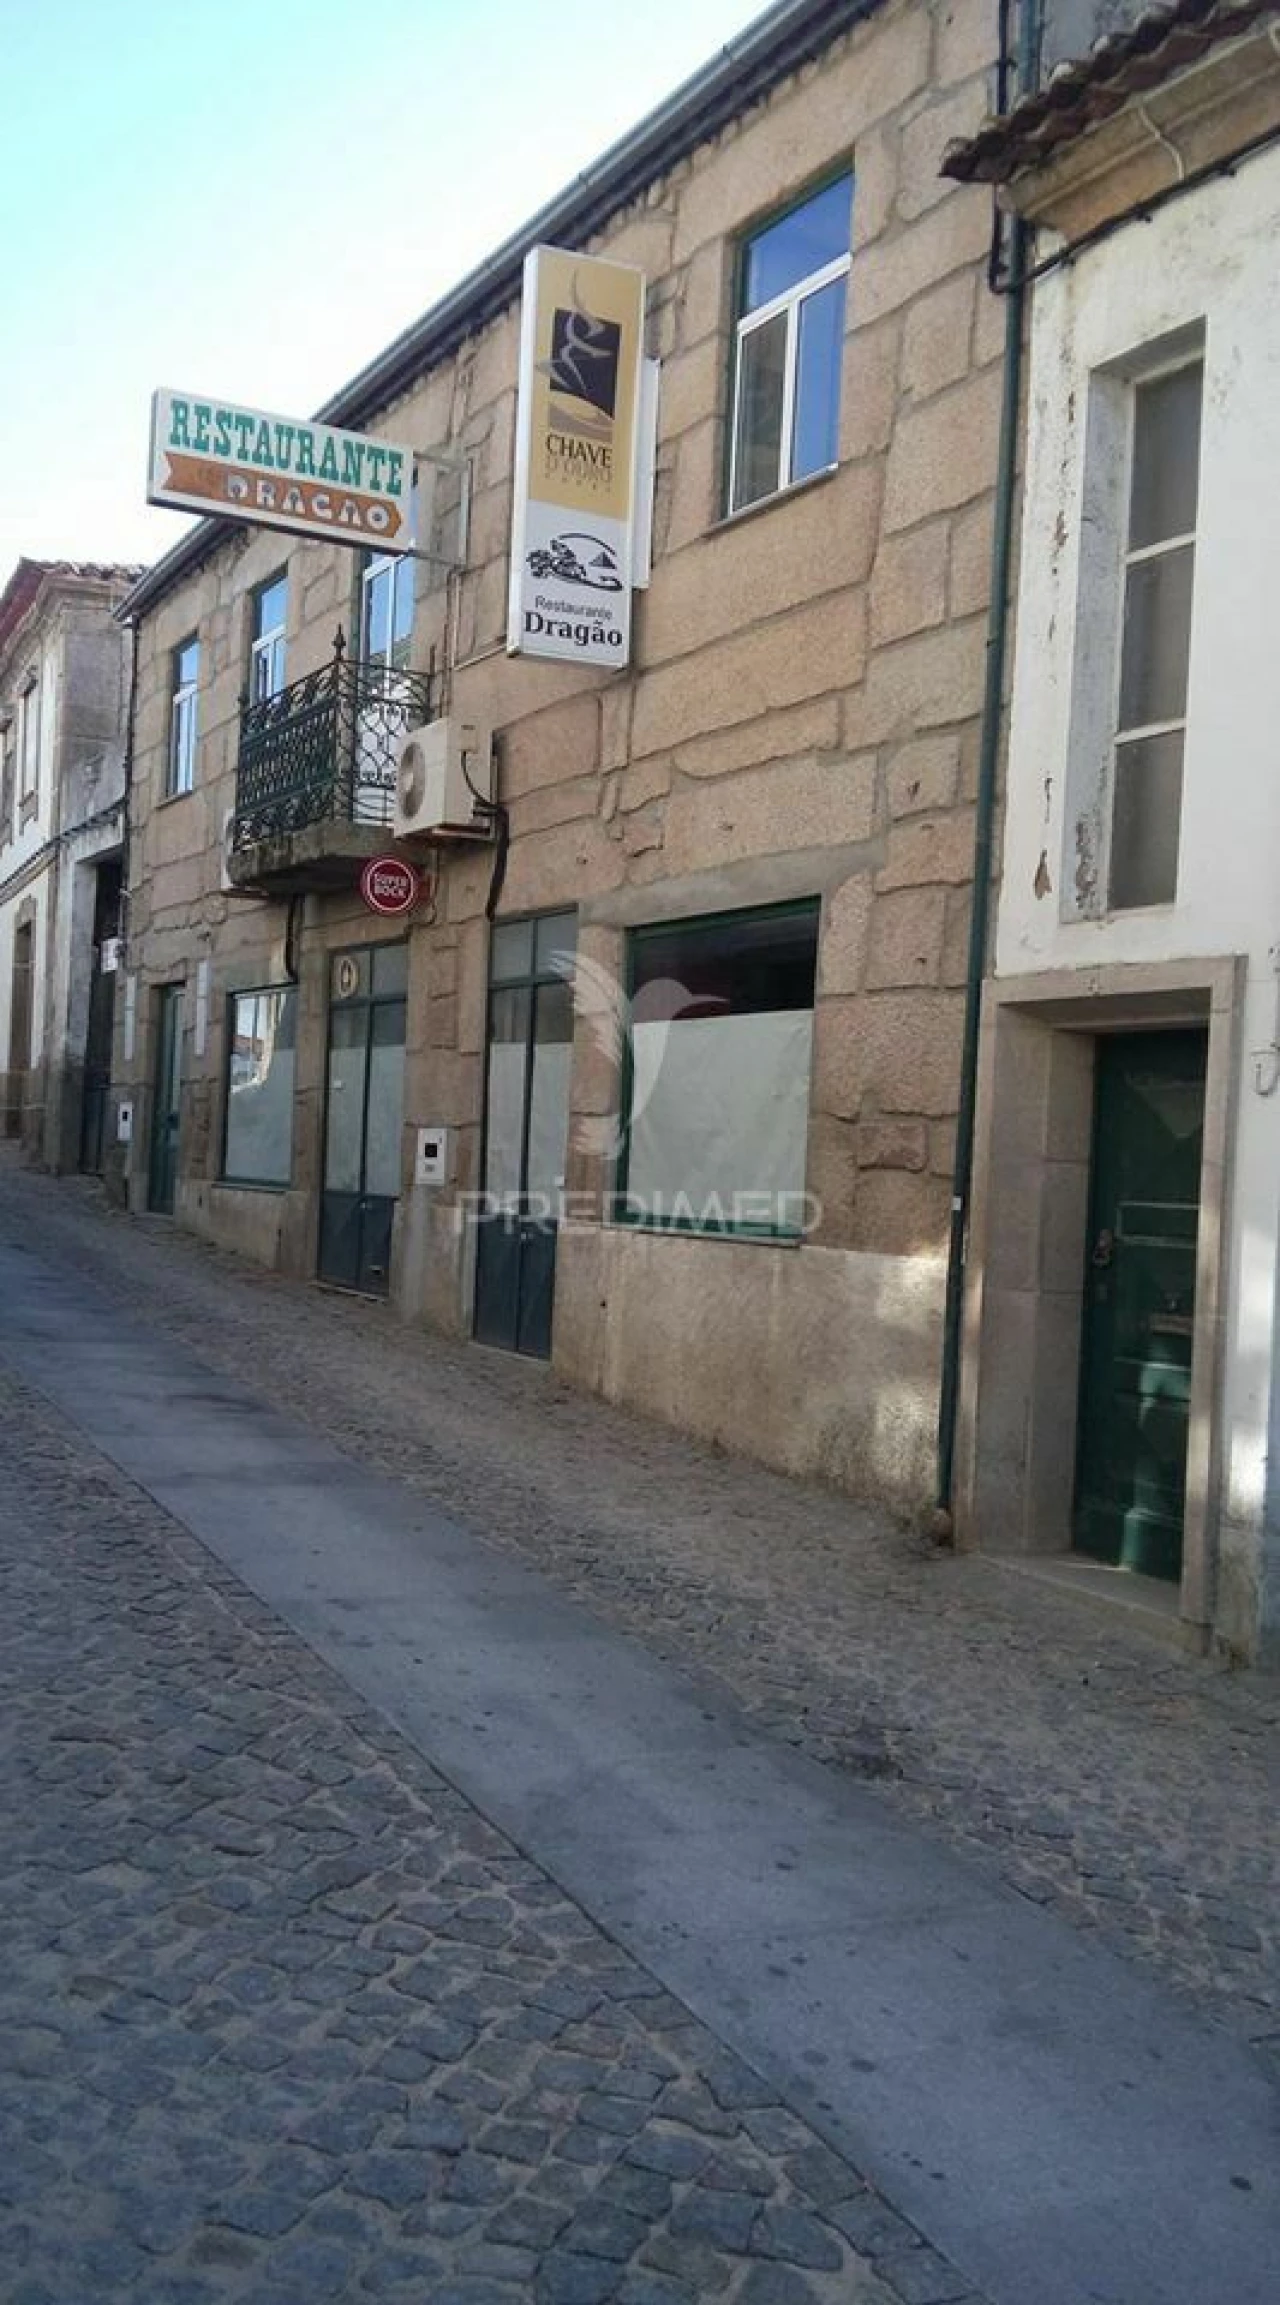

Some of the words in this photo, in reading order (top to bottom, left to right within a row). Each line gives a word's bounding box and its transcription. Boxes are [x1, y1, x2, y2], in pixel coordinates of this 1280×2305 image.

[169, 399, 403, 496] RESTAURANTE
[545, 434, 612, 467] CHAVE
[535, 595, 612, 620] Restaurante
[525, 610, 623, 647] Dragão
